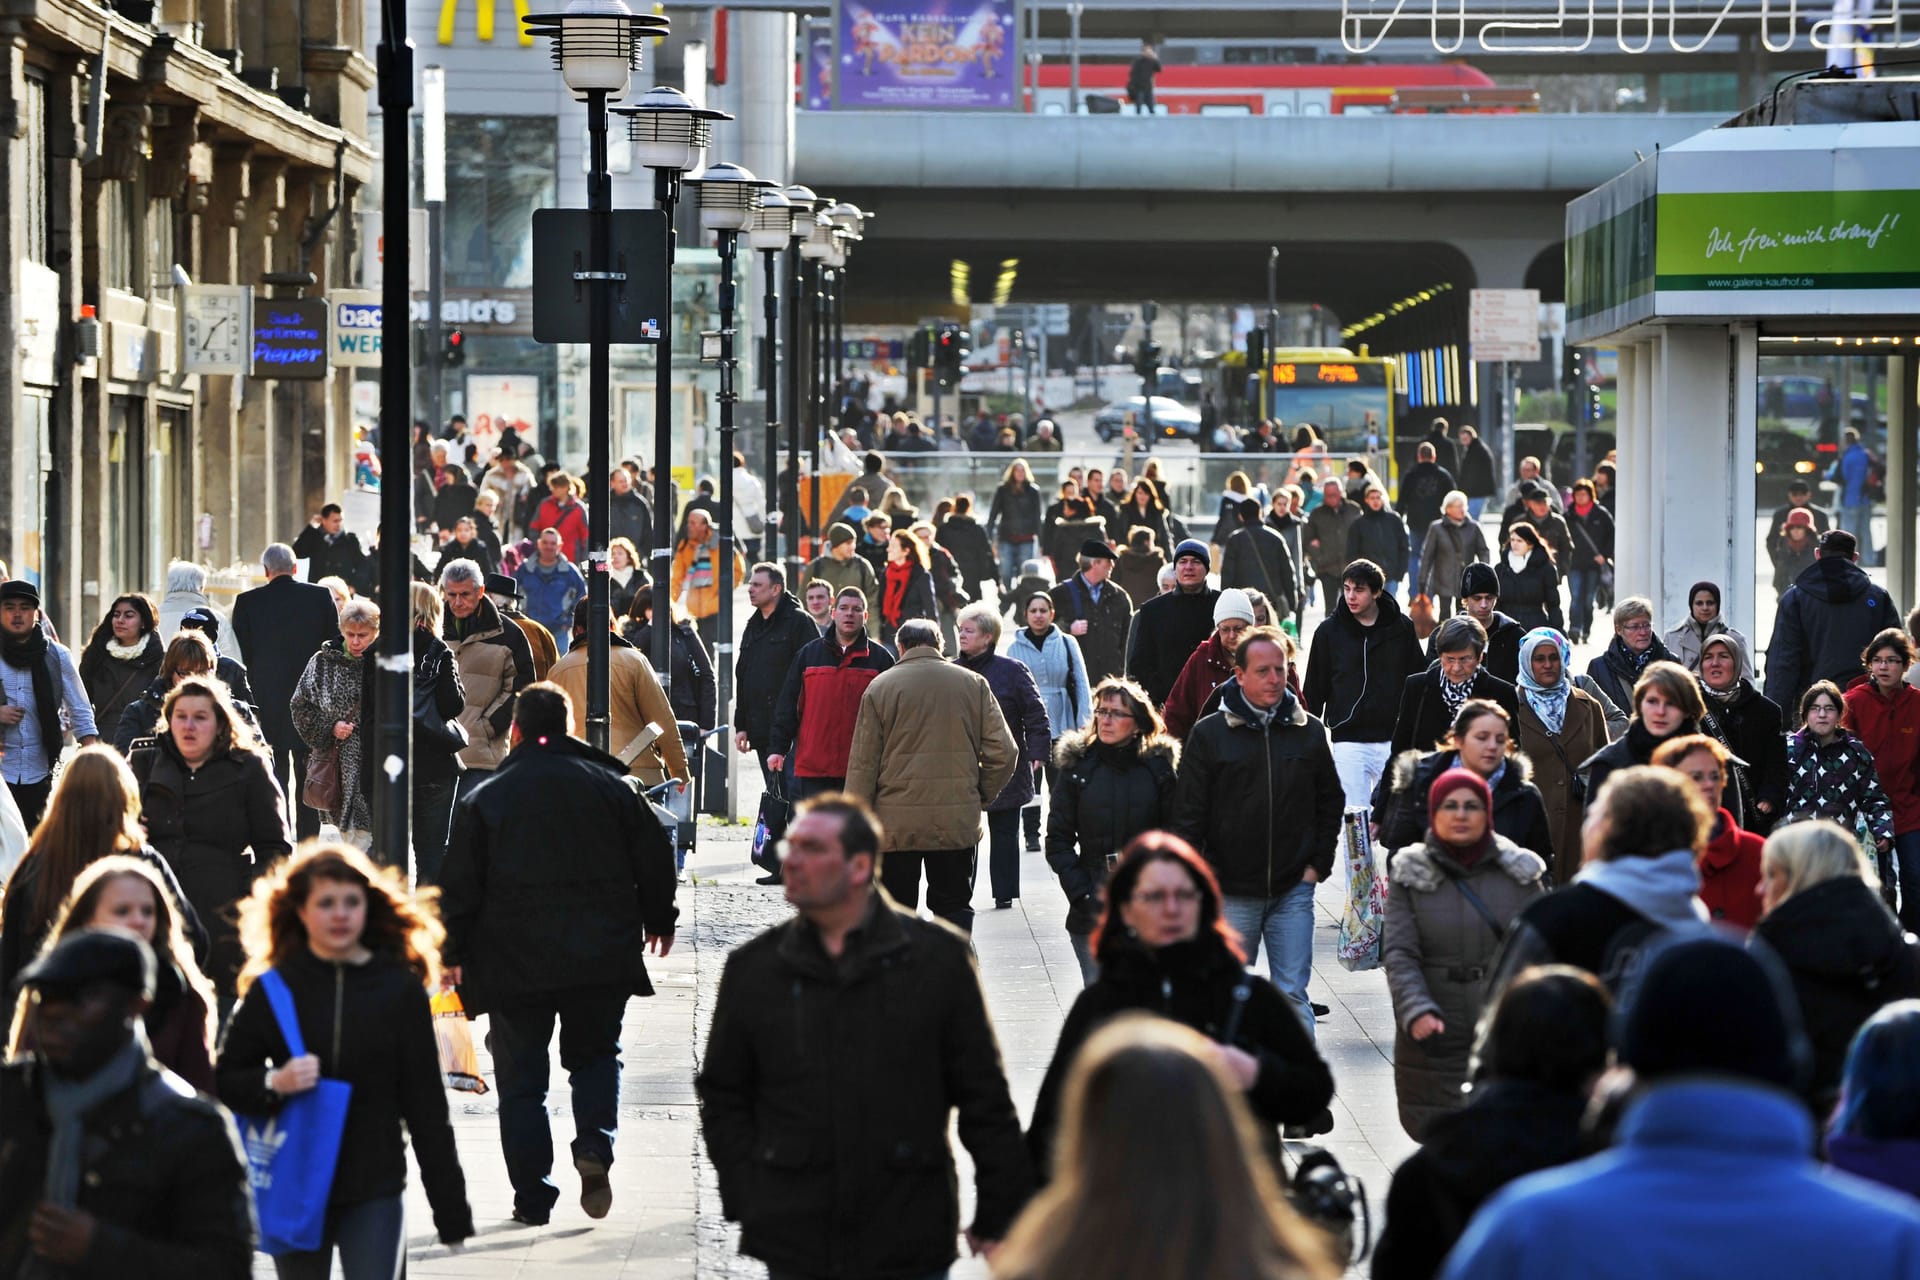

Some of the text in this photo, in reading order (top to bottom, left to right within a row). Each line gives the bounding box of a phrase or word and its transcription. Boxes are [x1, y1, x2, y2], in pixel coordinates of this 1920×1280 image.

[901, 23, 955, 43] KEIN
[878, 43, 979, 65] PARDON
[1706, 226, 1734, 259] Ich
[1707, 277, 1815, 288] www.galeria-kaufhof.de
